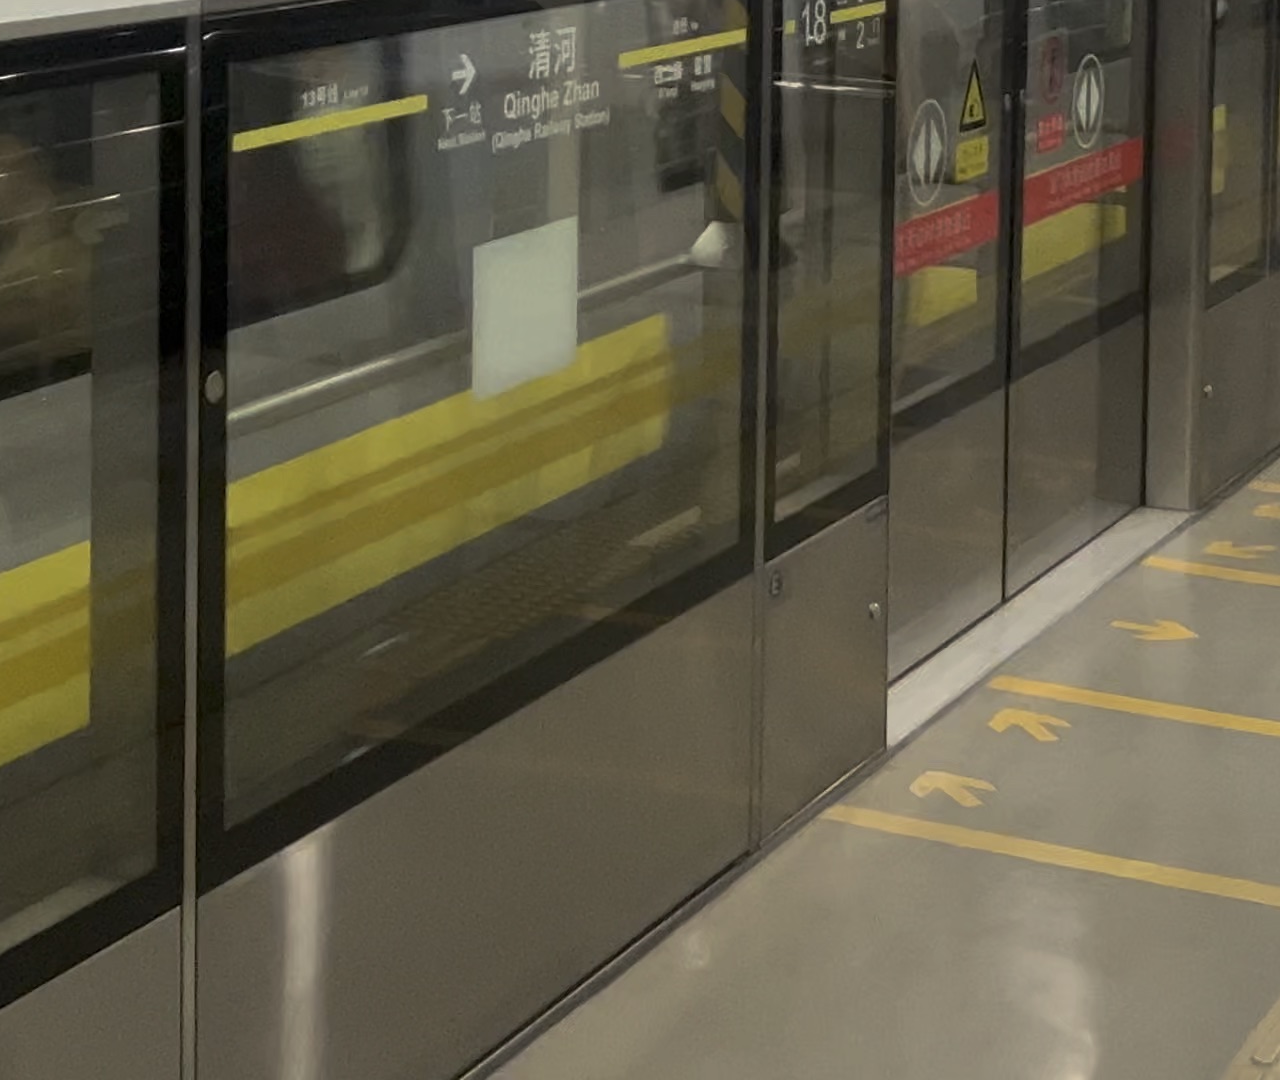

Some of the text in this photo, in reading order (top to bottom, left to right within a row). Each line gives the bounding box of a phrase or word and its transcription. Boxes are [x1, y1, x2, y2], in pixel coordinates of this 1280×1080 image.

[528, 26, 577, 79] 清河
[504, 80, 600, 119] Qinghe Zhan
